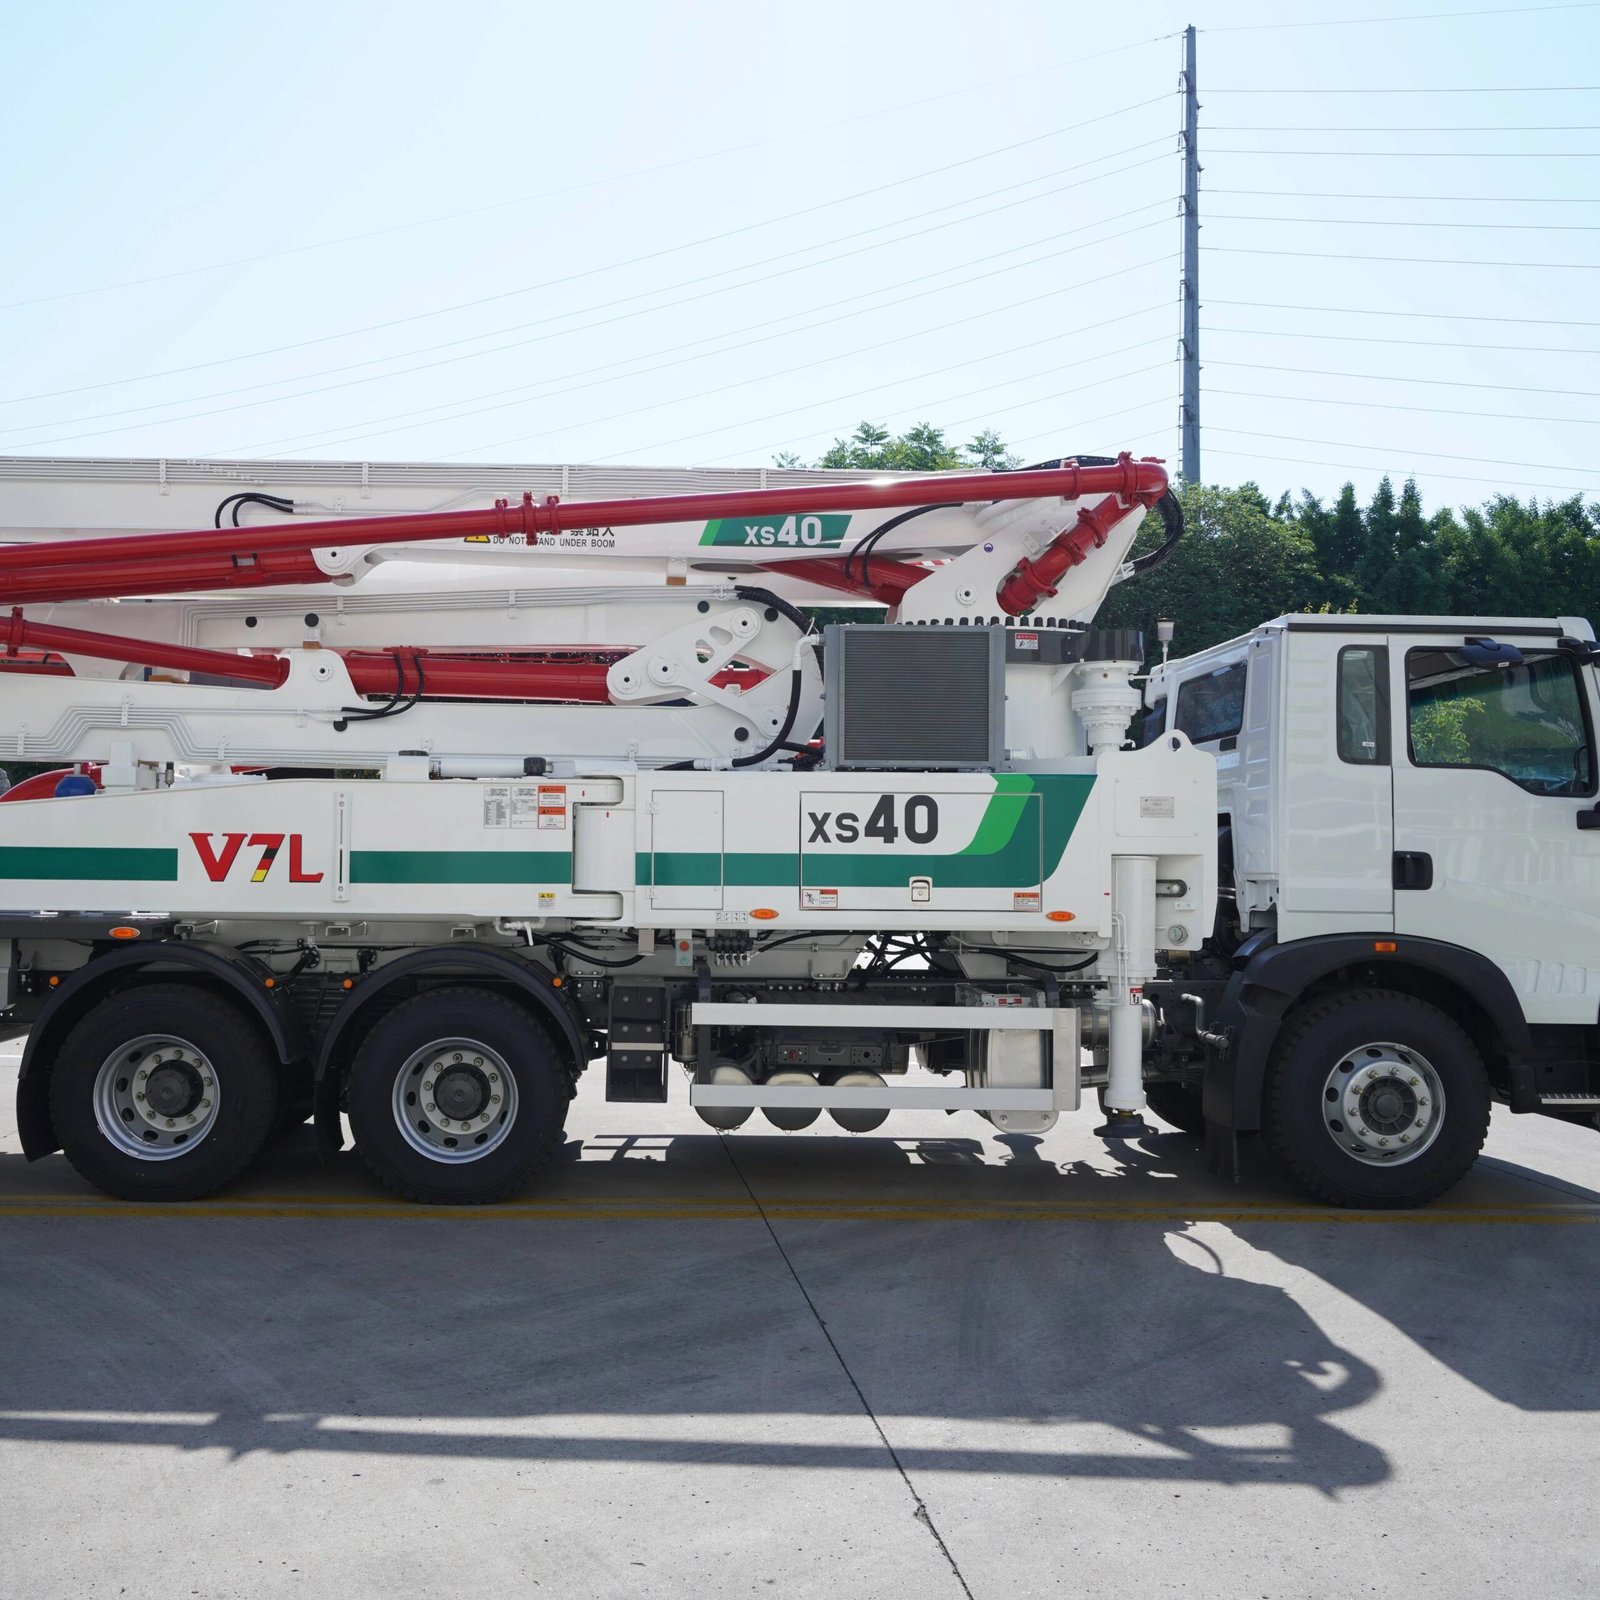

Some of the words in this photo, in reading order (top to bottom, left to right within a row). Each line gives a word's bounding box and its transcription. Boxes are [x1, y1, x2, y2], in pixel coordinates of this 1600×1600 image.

[493, 536, 505, 545] DO
[508, 536, 526, 545] NOT
[536, 537, 556, 546] AND
[559, 538, 587, 547] UNDER
[591, 539, 616, 548] BOOM
[188, 832, 325, 884] V7L
